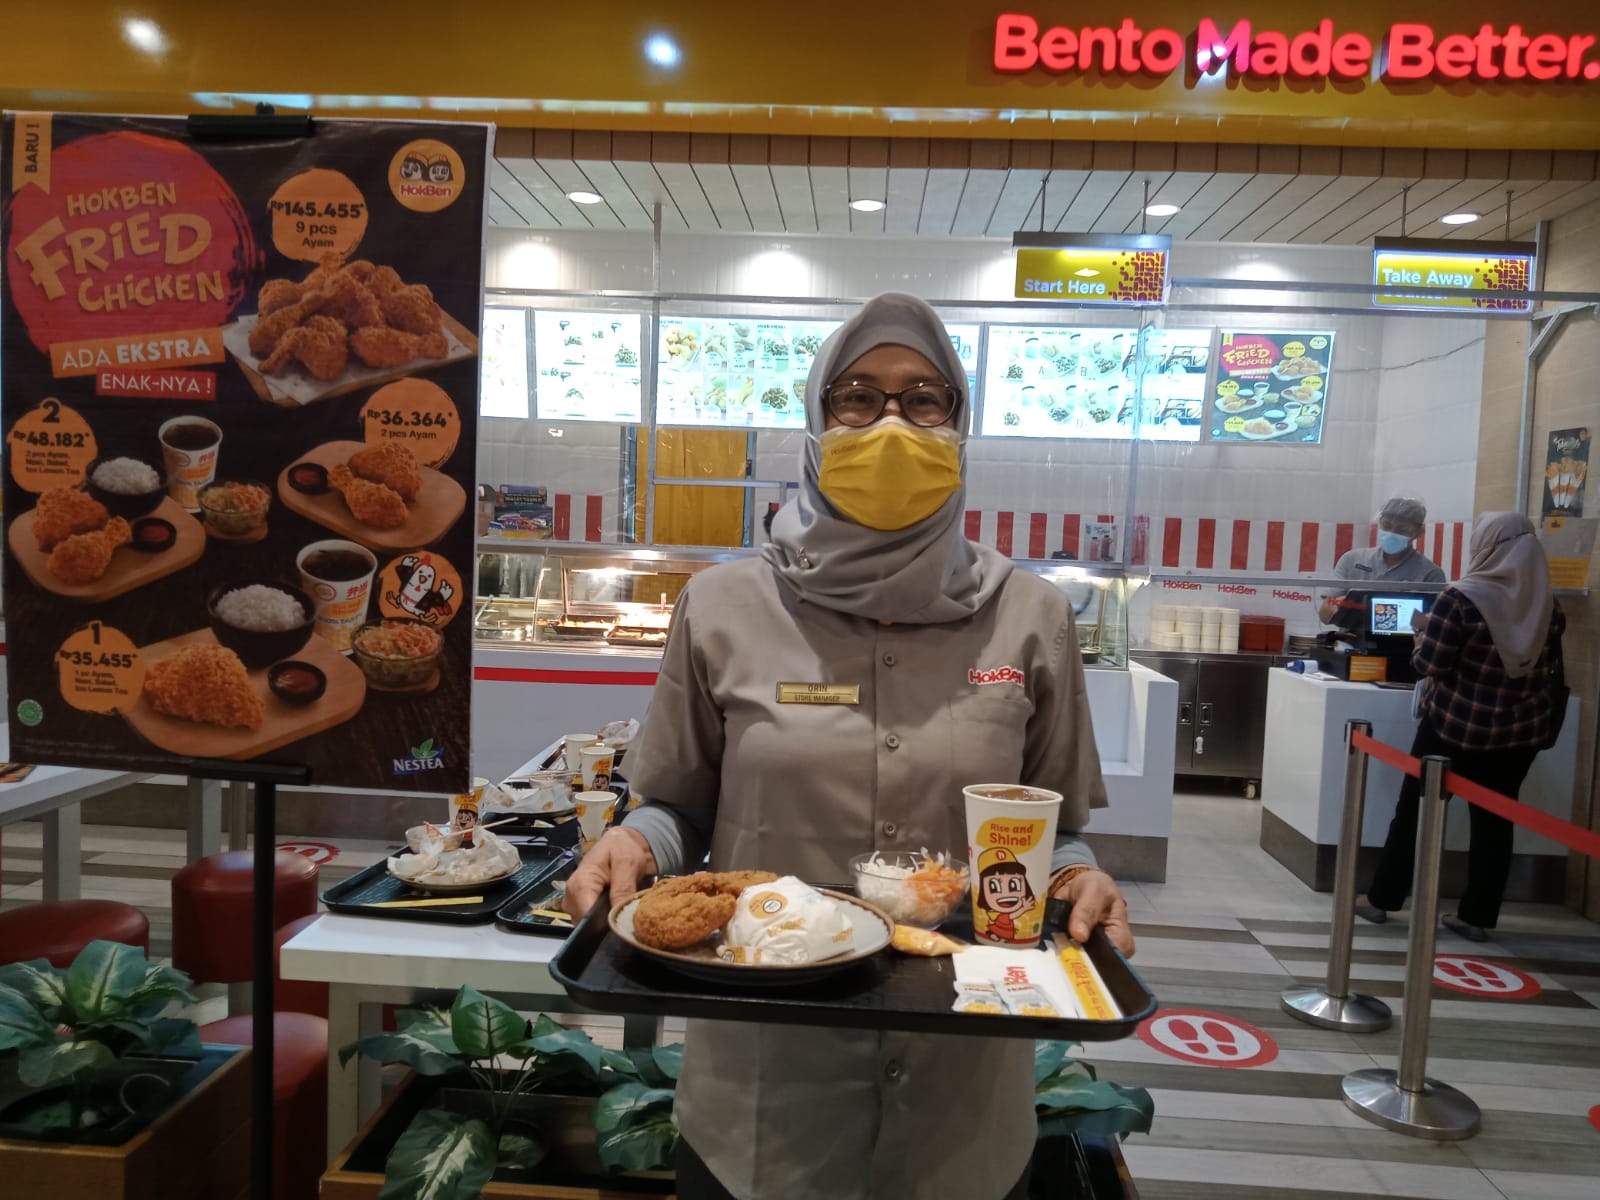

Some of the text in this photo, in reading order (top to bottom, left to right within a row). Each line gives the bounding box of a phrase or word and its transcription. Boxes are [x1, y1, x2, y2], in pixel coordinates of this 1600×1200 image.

[993, 13, 1600, 80] Bento Made Better.
[25, 132, 40, 173] BARU
[400, 184, 452, 196] HokBen
[67, 182, 177, 216] HOKBEN
[295, 220, 337, 236] 9 pcs
[302, 237, 334, 248] Ayam
[1382, 268, 1473, 289] Take Away
[1023, 279, 1106, 294] Start Here
[62, 337, 210, 369] ADA EKSTRA
[101, 374, 200, 393] ENAK-NYA
[42, 401, 60, 423] 2
[381, 429, 437, 439] 2 pcs Ayam
[1163, 580, 1202, 591] HokBen
[1217, 583, 1257, 596] HokBen
[1272, 589, 1312, 603] HokBen
[91, 623, 101, 645] 1
[393, 758, 445, 772] NESTEA
[990, 823, 1033, 834] Rise and
[990, 833, 1032, 847] Shine!
